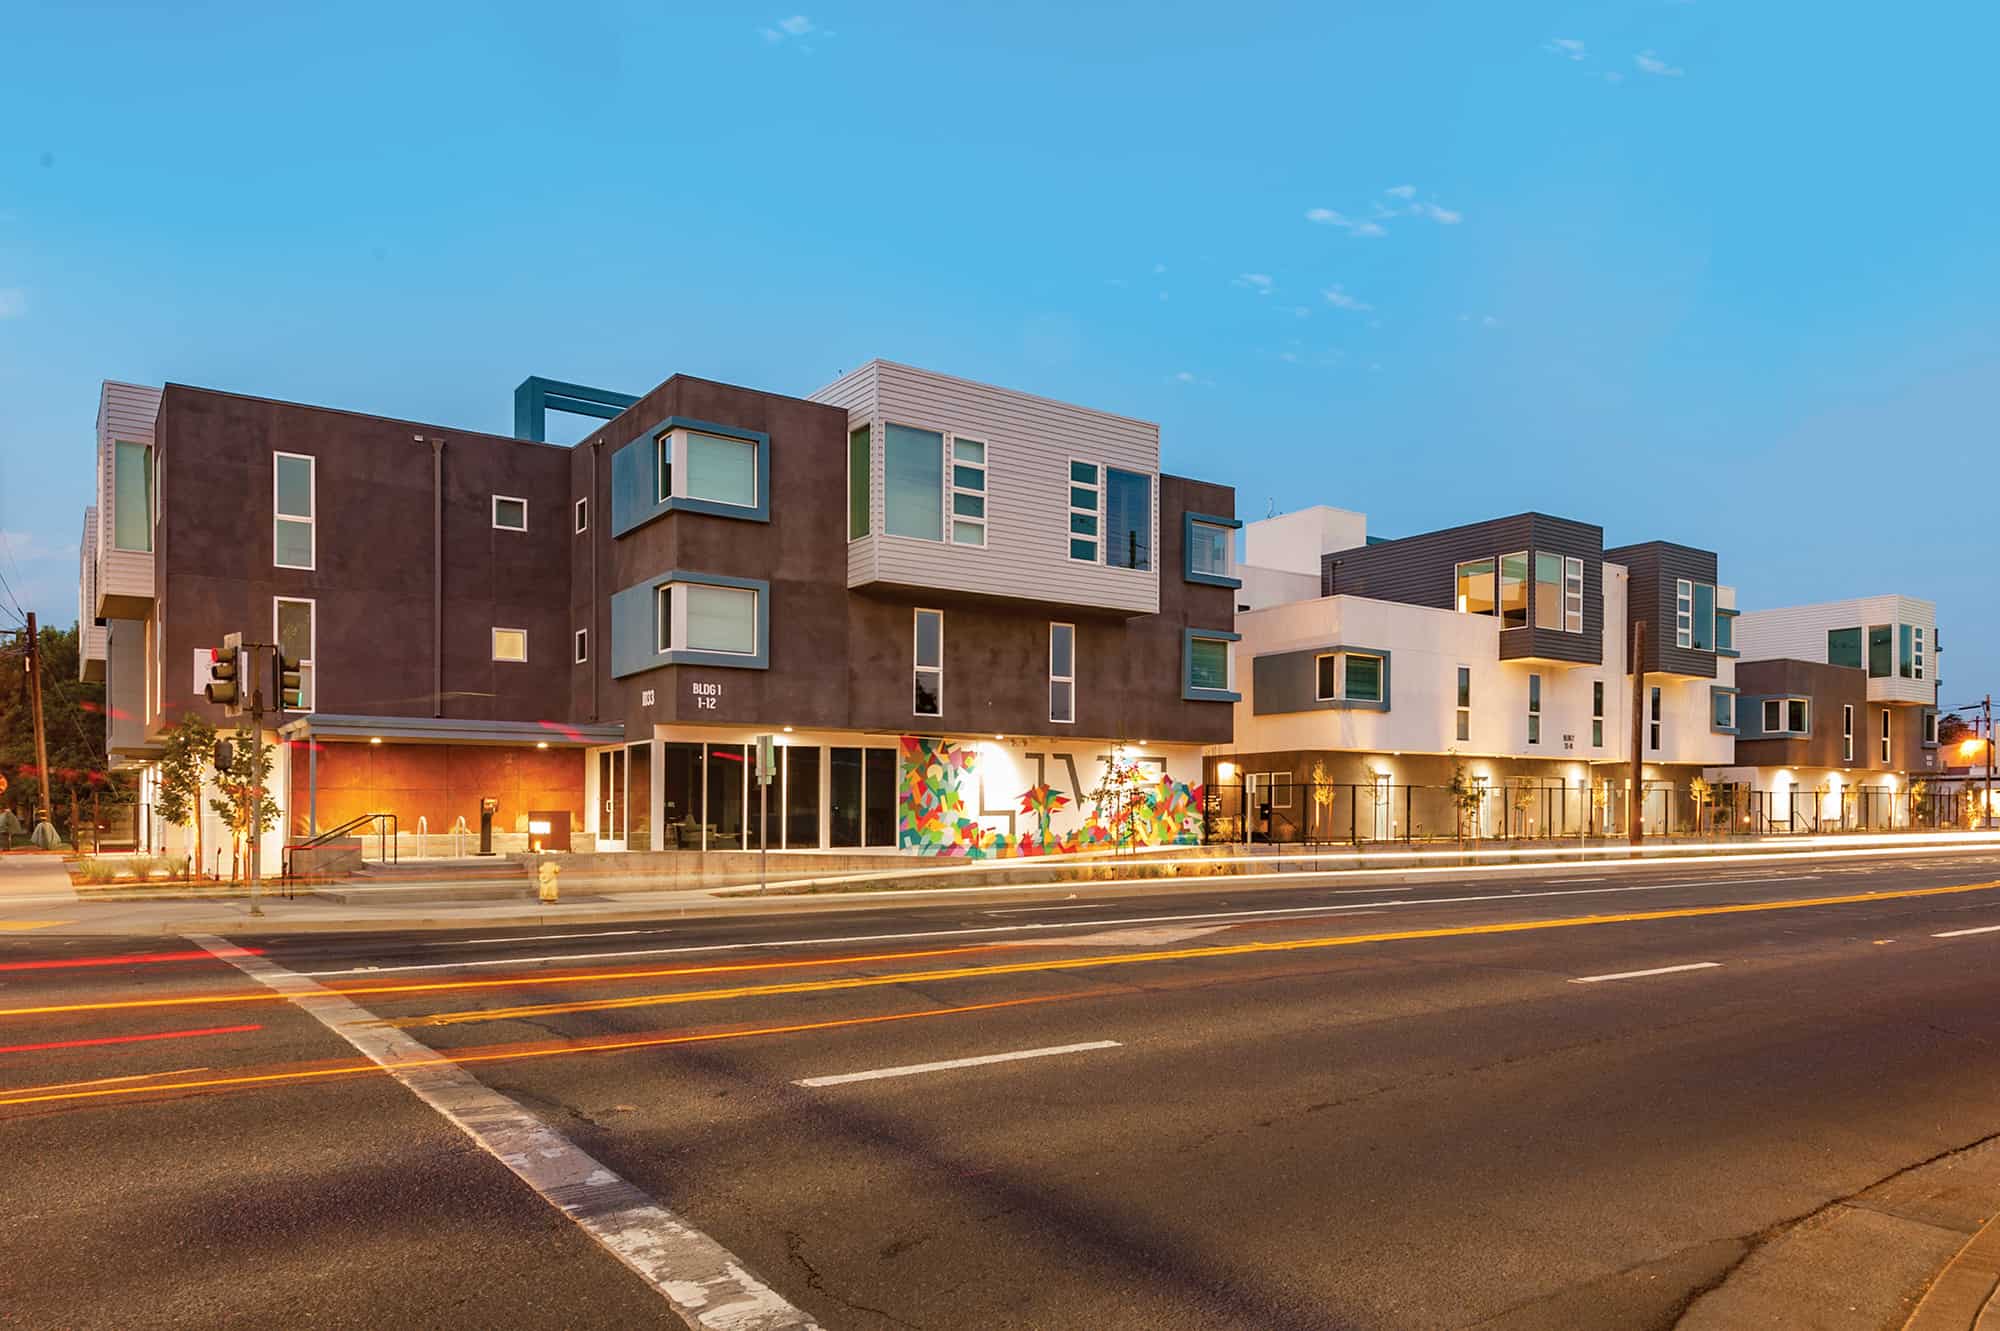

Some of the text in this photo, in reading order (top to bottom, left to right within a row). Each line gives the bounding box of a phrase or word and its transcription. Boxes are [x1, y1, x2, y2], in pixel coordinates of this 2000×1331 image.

[692, 682, 722, 696] BLDG 1
[697, 697, 717, 709] 1-12
